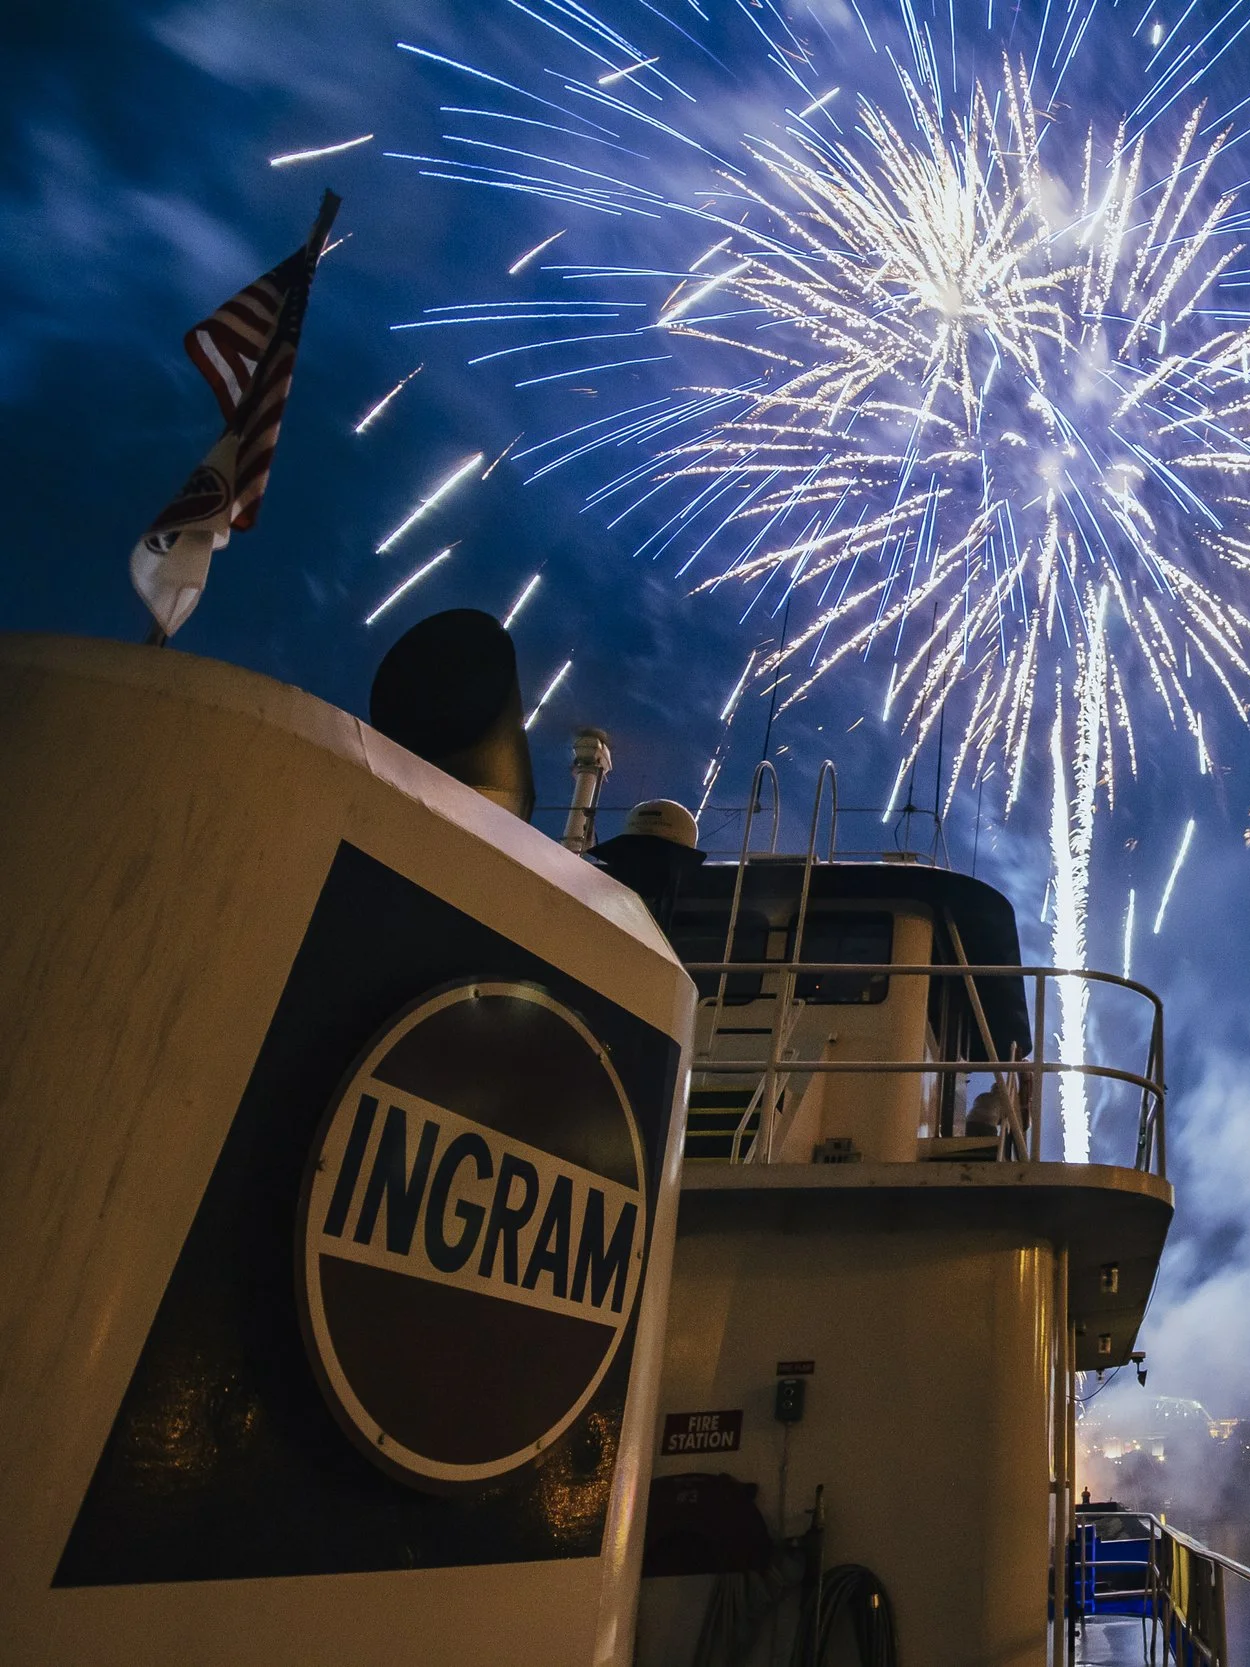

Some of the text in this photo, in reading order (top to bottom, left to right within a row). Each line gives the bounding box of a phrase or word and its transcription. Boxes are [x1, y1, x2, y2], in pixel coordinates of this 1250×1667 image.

[322, 1093, 638, 1314] INGRAM
[688, 1415, 720, 1432] FIRE
[668, 1431, 735, 1450] STATION
